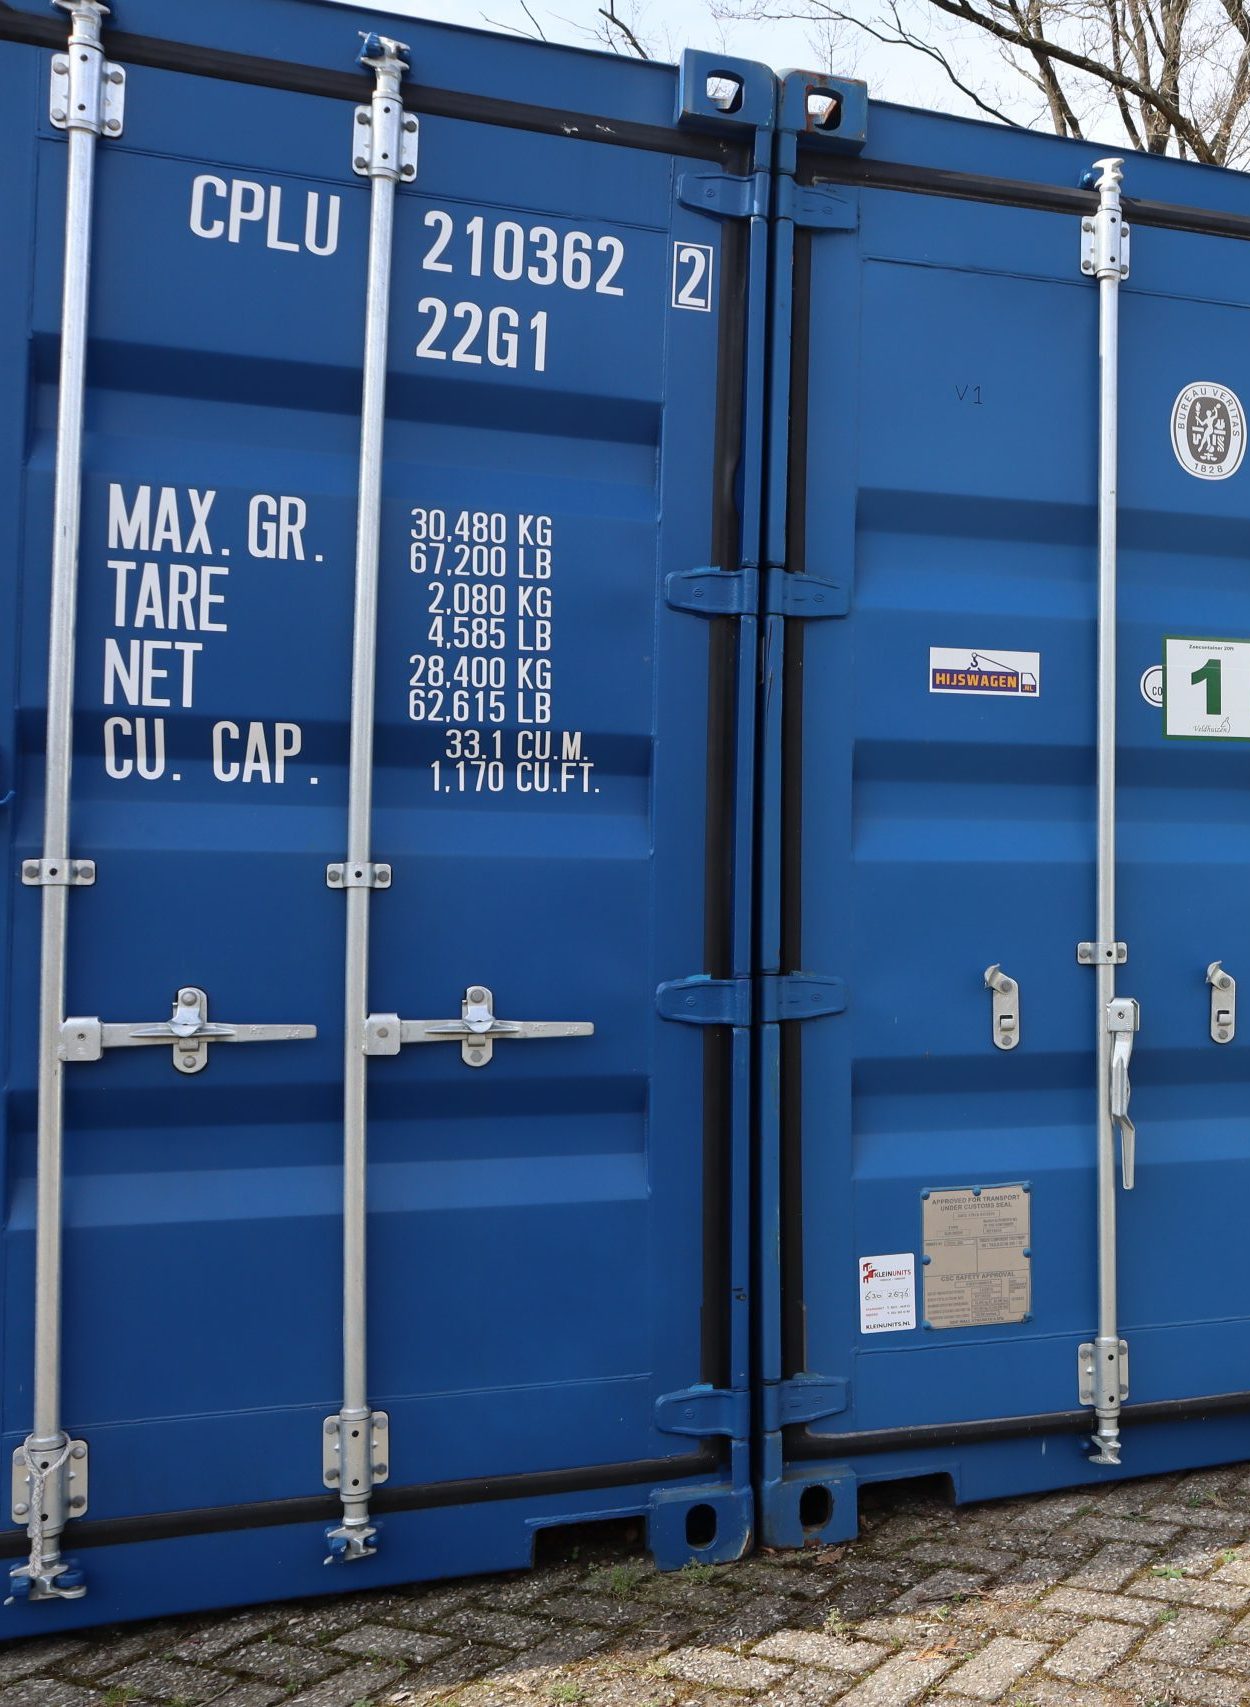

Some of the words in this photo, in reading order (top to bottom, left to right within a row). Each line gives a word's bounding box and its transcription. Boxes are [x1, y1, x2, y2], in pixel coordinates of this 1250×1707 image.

[190, 175, 341, 256] CPLU
[423, 211, 624, 296] 210362
[678, 247, 706, 307] 2
[417, 298, 547, 372] 22G1
[1177, 387, 1207, 430] BUREAU
[1212, 388, 1240, 437] VERITAS
[1194, 463, 1223, 474] 1828
[108, 484, 230, 556] MAX.
[248, 495, 323, 561] GR.
[410, 508, 506, 543] 30,480
[518, 514, 552, 547] KG
[410, 541, 506, 577] 67,200
[518, 547, 552, 580] LB
[107, 561, 229, 632] TARE
[428, 583, 506, 616] 2,080
[518, 585, 552, 617] KG
[428, 617, 506, 651] 4,585
[518, 619, 552, 652] LB
[104, 639, 203, 708] NET
[409, 654, 506, 689] 28,400
[518, 657, 551, 690] KG
[935, 672, 1017, 688] HIJSWAGEN
[1191, 658, 1222, 715] 1
[409, 688, 505, 723] 62,615
[517, 691, 551, 724] LB
[104, 717, 181, 781] CU.
[212, 721, 318, 785] CAP.
[445, 729, 501, 759] 33.1
[517, 730, 588, 761] CU.M.
[431, 760, 504, 793] 1,170
[516, 761, 600, 793] CU.FT.
[940, 1204, 963, 1212] UNDER
[963, 1202, 995, 1211] CUSTOMS
[982, 1194, 1020, 1202] TRANSPORT
[874, 1269, 911, 1278] KLEINUNITS
[981, 1271, 1015, 1279] APPROVAL
[865, 1321, 911, 1330] KLEINUNITS.NL
